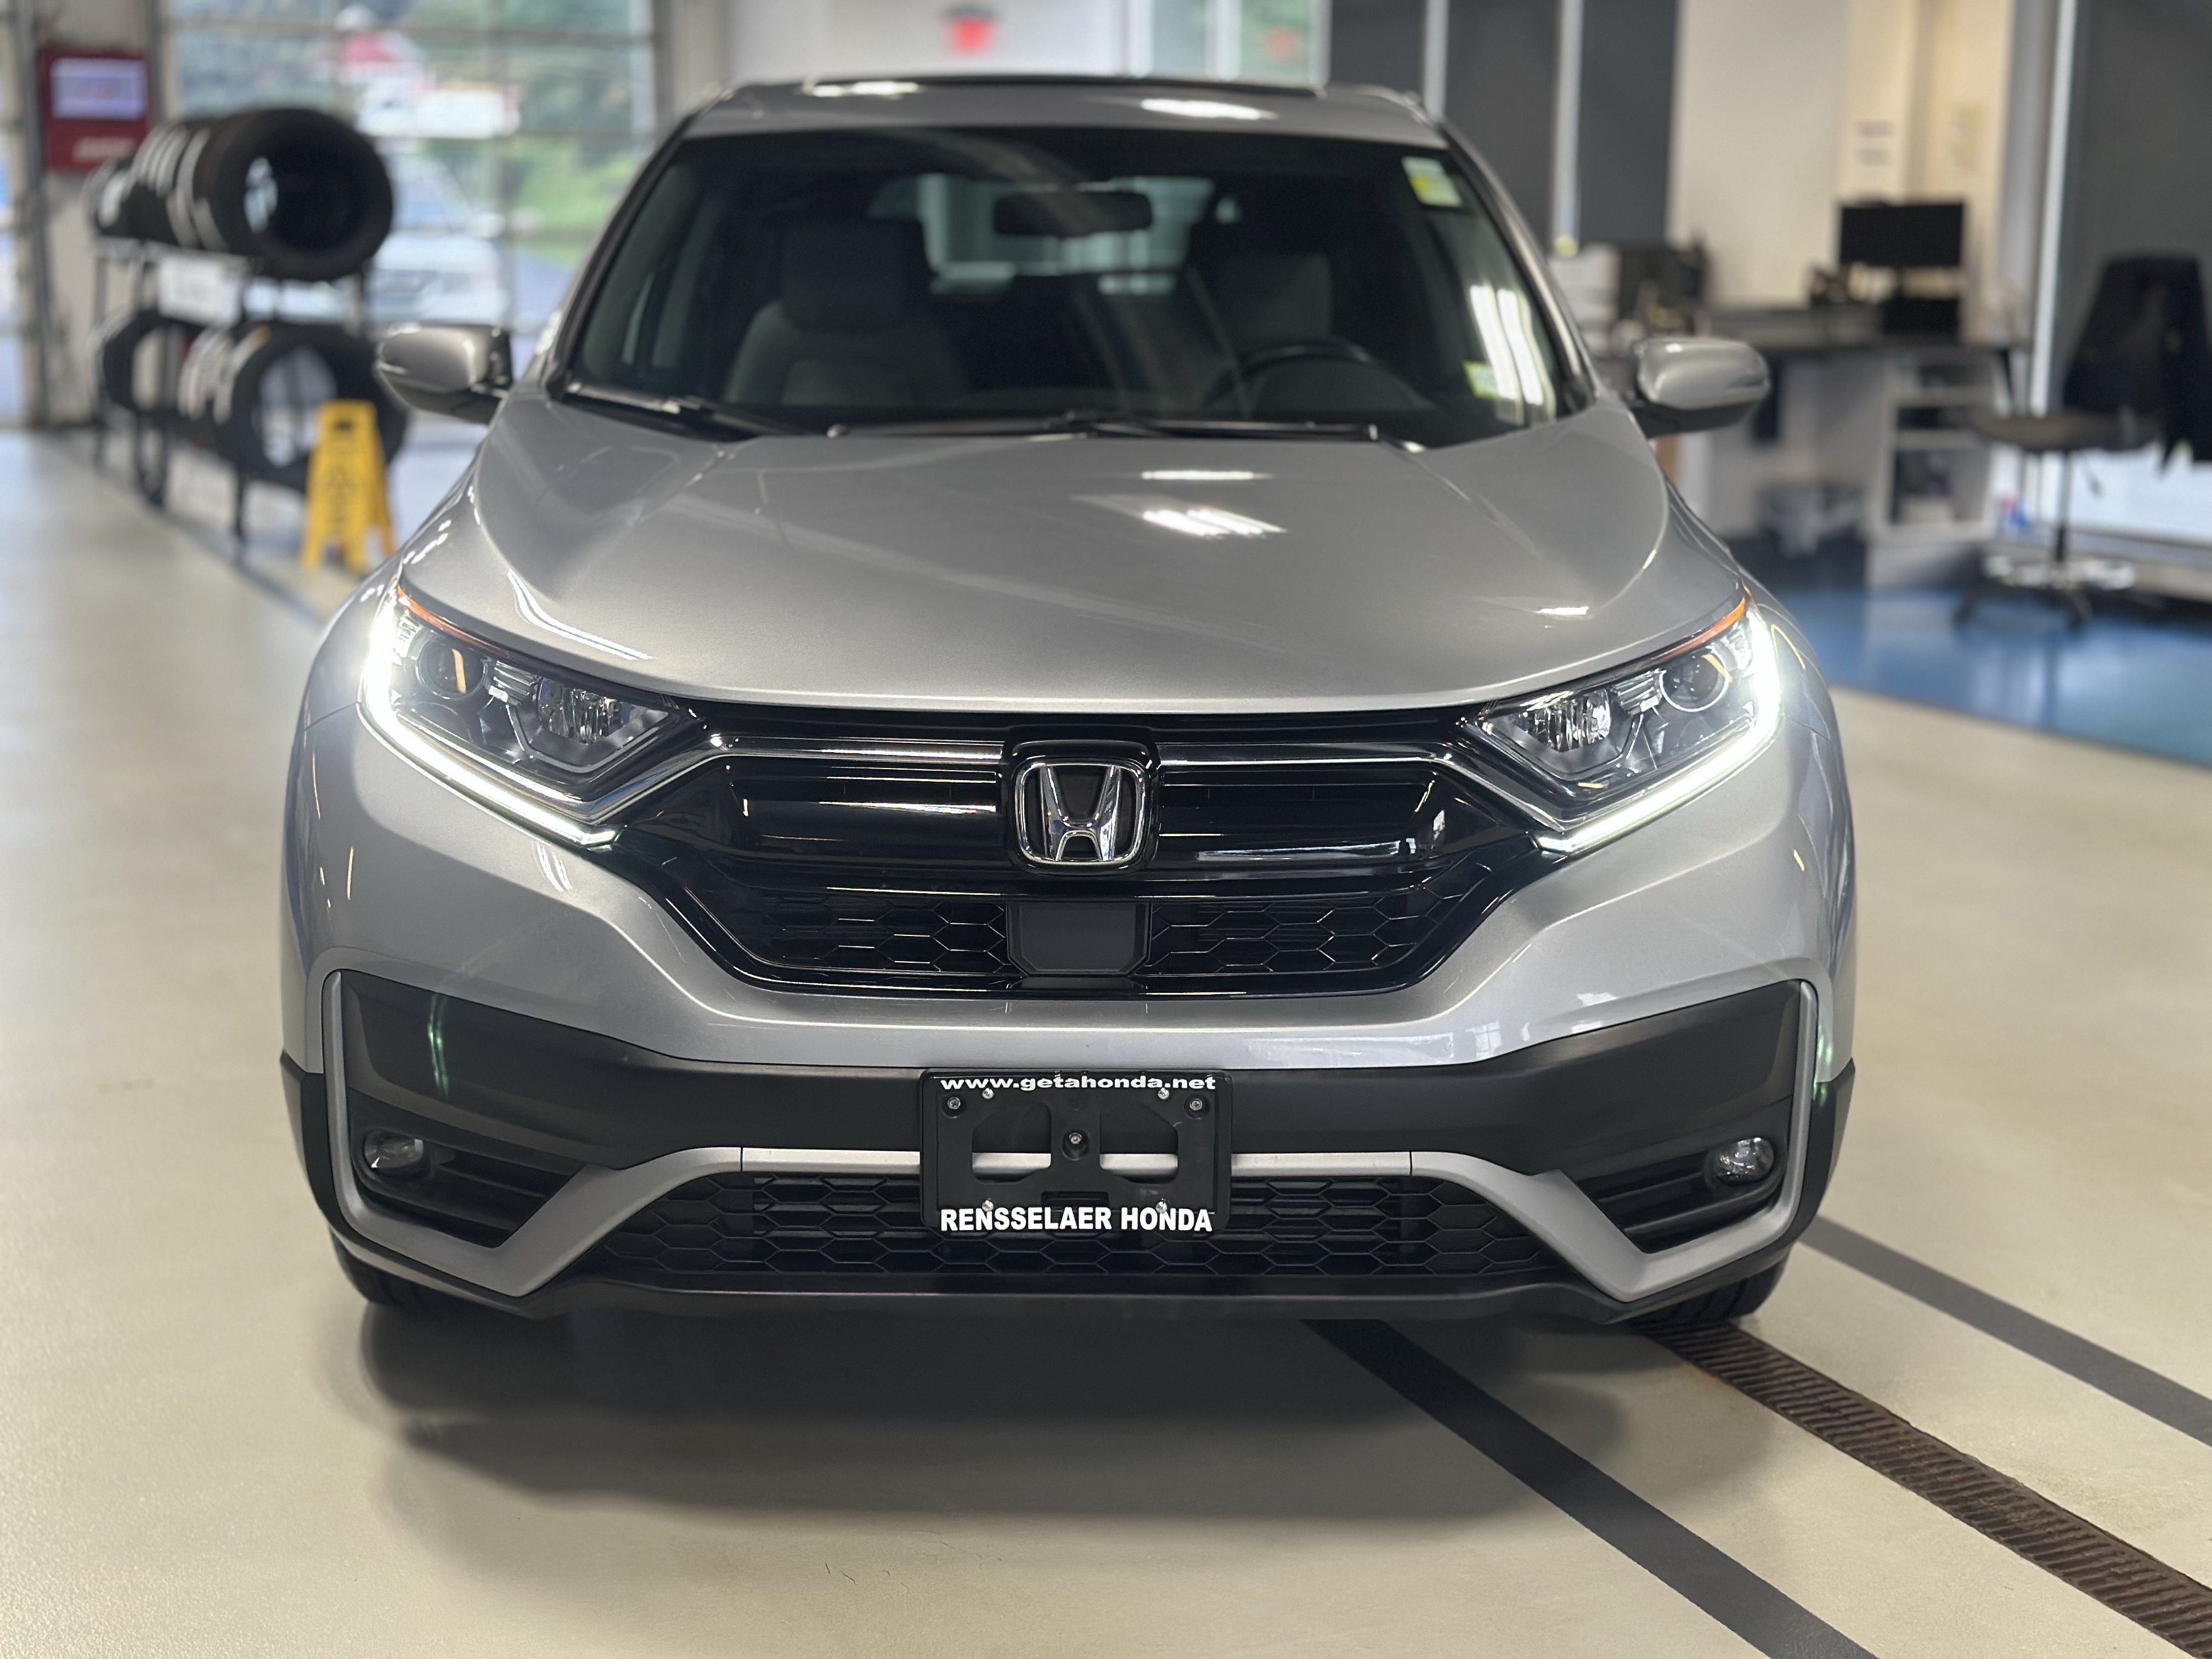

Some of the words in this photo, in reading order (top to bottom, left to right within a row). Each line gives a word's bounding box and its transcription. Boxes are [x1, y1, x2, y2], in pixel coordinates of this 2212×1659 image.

[940, 1076, 1216, 1090] www.getahonda.net
[940, 1207, 1112, 1232] RENSSELAER
[1120, 1207, 1213, 1232] HONDA
